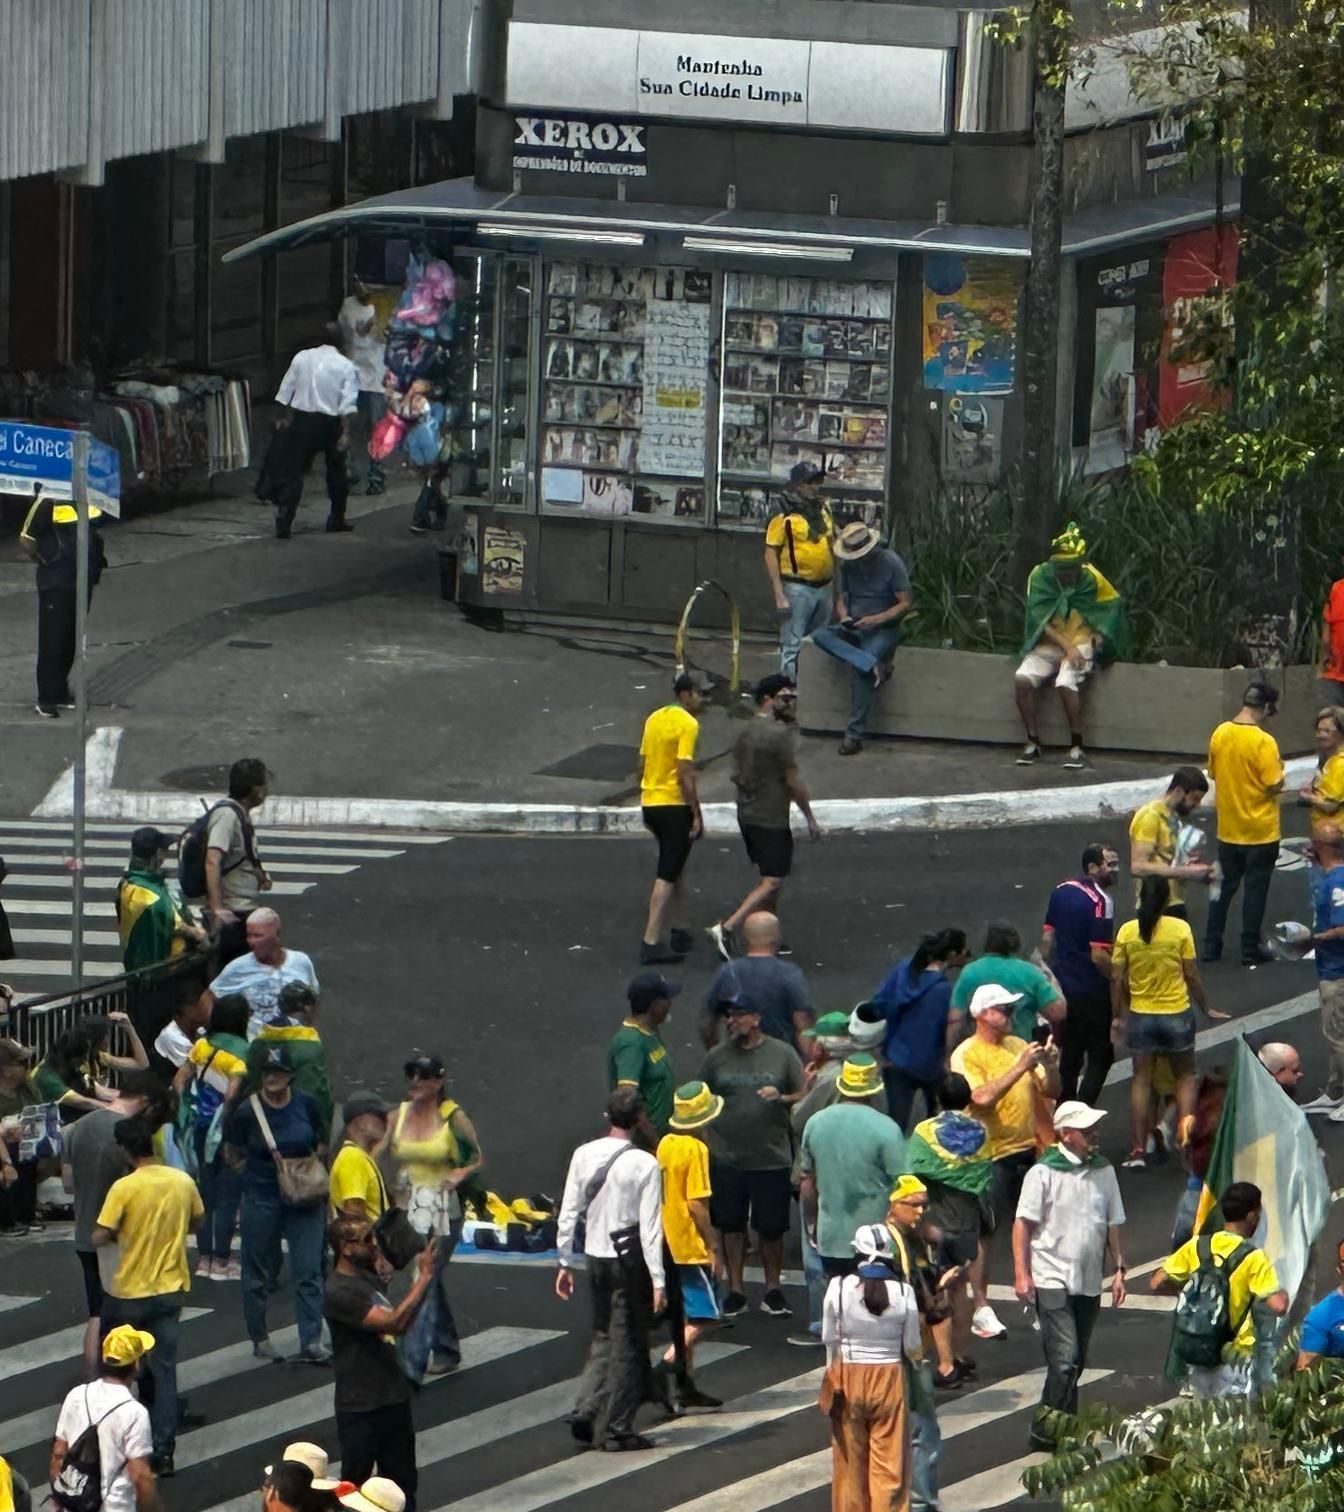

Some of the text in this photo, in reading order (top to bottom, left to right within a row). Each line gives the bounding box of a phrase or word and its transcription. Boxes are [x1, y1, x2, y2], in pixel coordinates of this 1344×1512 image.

[677, 55, 763, 76] Mantenha
[640, 78, 803, 106] Sua Cidade Limpa
[514, 117, 647, 153] XEROX
[14, 430, 74, 459] Caneca
